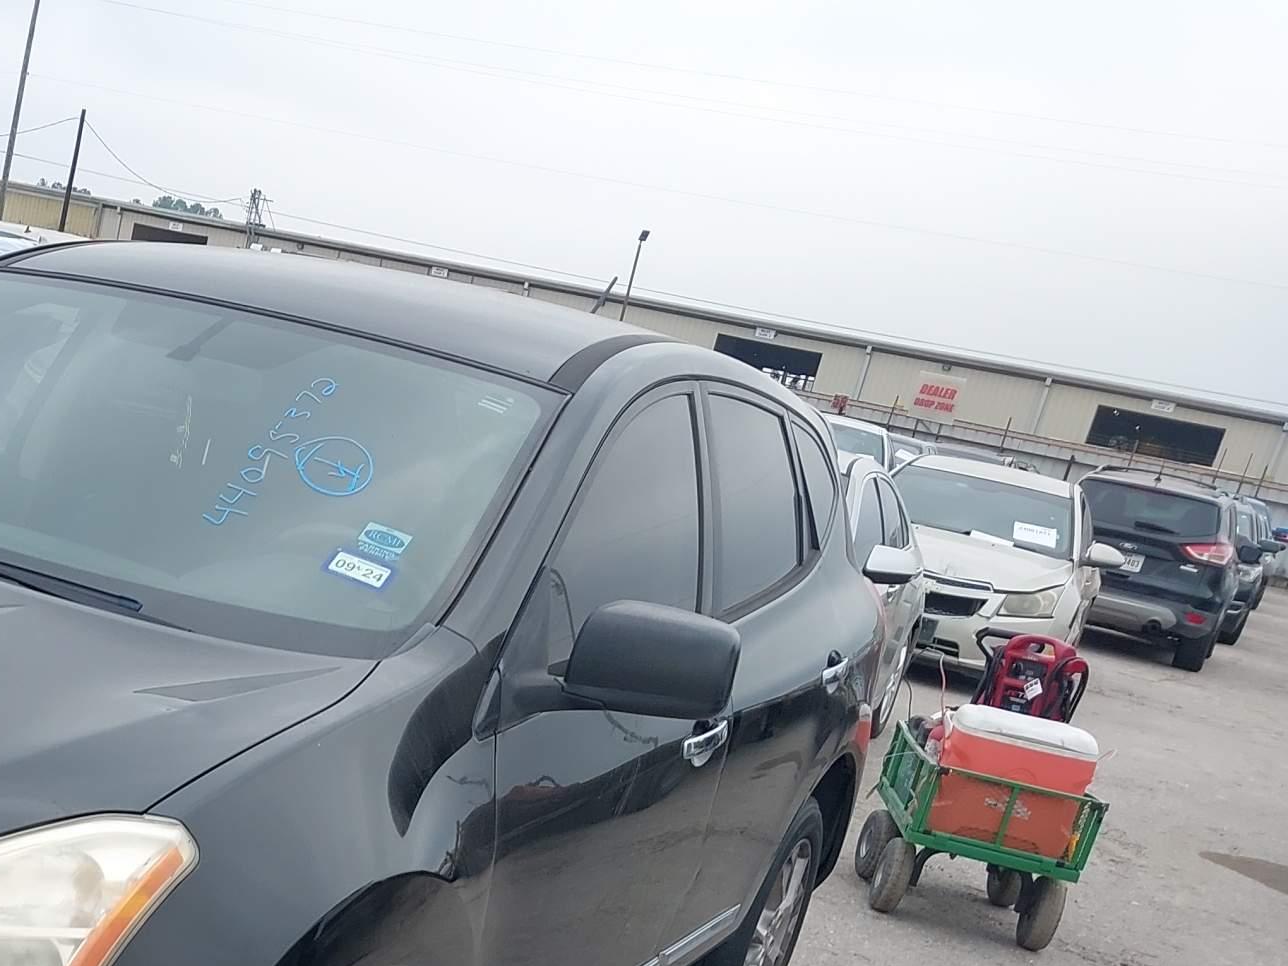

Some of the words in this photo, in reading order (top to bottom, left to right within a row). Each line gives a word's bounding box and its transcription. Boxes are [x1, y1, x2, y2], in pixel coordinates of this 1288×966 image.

[919, 383, 958, 400] DEALER
[913, 397, 936, 408] DROP
[935, 401, 955, 413] ZONE
[202, 377, 340, 525] 44095372
